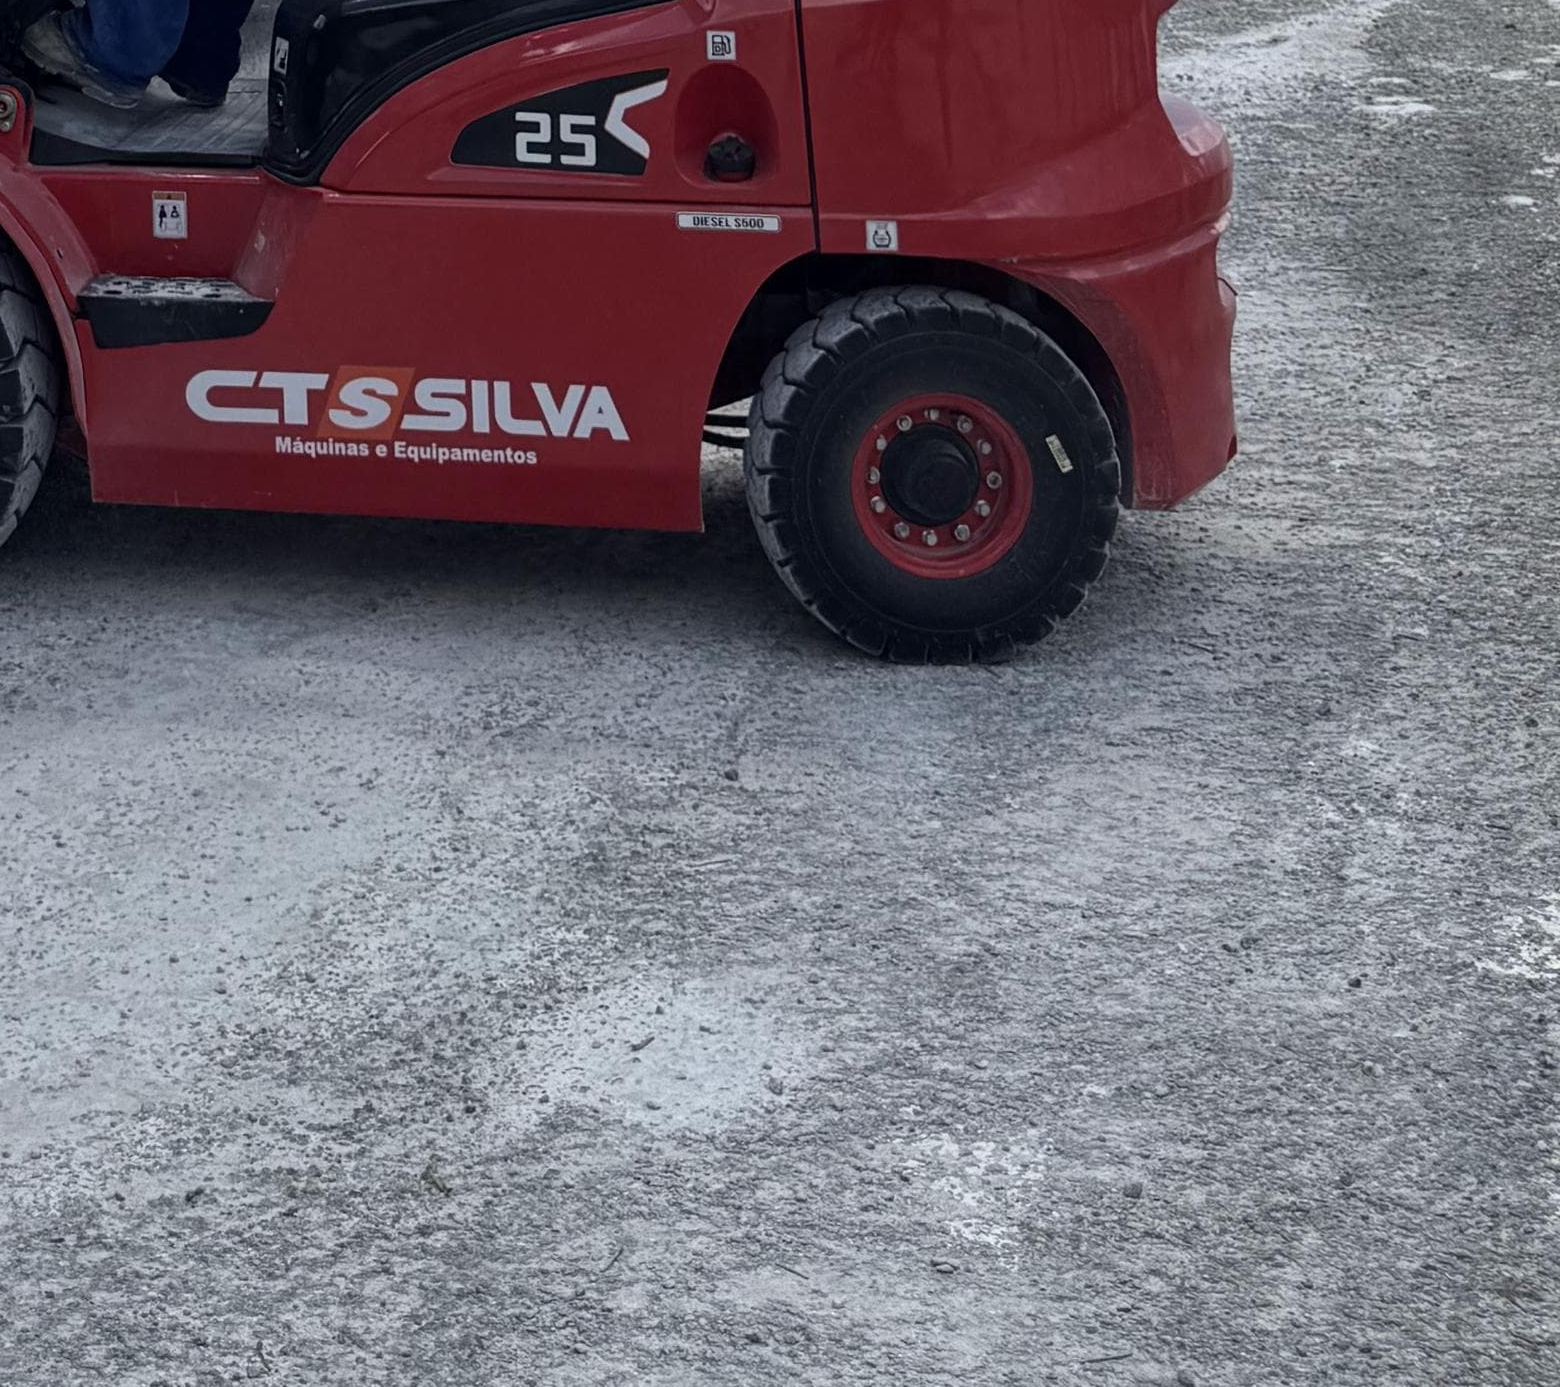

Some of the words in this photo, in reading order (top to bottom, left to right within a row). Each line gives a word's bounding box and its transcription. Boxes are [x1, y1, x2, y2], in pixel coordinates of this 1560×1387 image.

[515, 112, 596, 166] 25
[692, 216, 732, 228] DIESEL
[275, 436, 369, 459] Máquinas
[375, 444, 388, 457] e
[393, 441, 538, 465] Equipamentos
